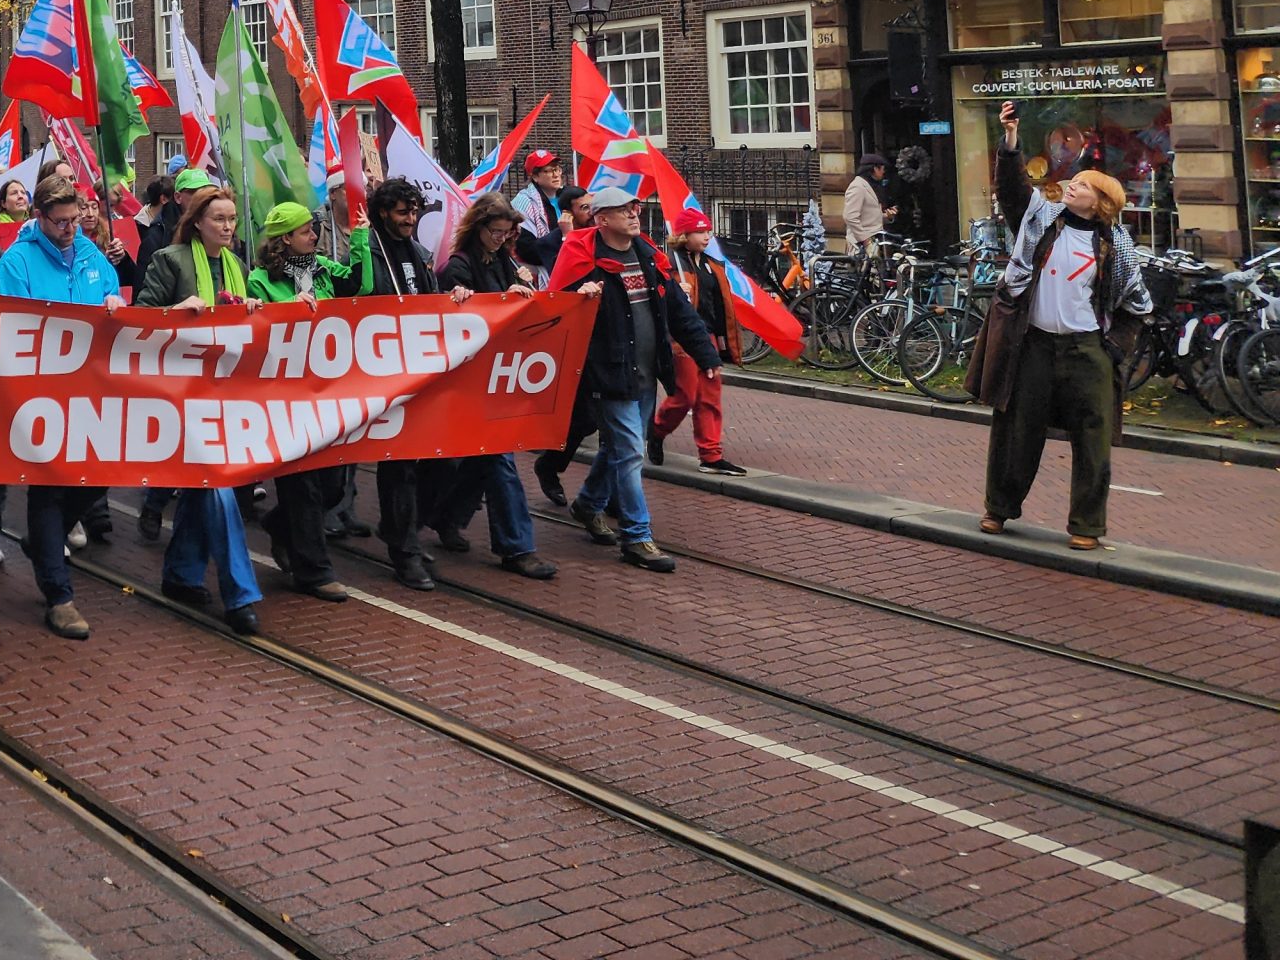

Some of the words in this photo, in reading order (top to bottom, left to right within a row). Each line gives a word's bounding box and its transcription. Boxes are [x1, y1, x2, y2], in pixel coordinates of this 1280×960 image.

[817, 32, 833, 44] 361
[922, 124, 950, 133] OPEN
[109, 323, 253, 378] HET
[259, 312, 490, 379] HOGER
[488, 351, 556, 394] HO
[9, 393, 418, 465] ONDERWIJS
